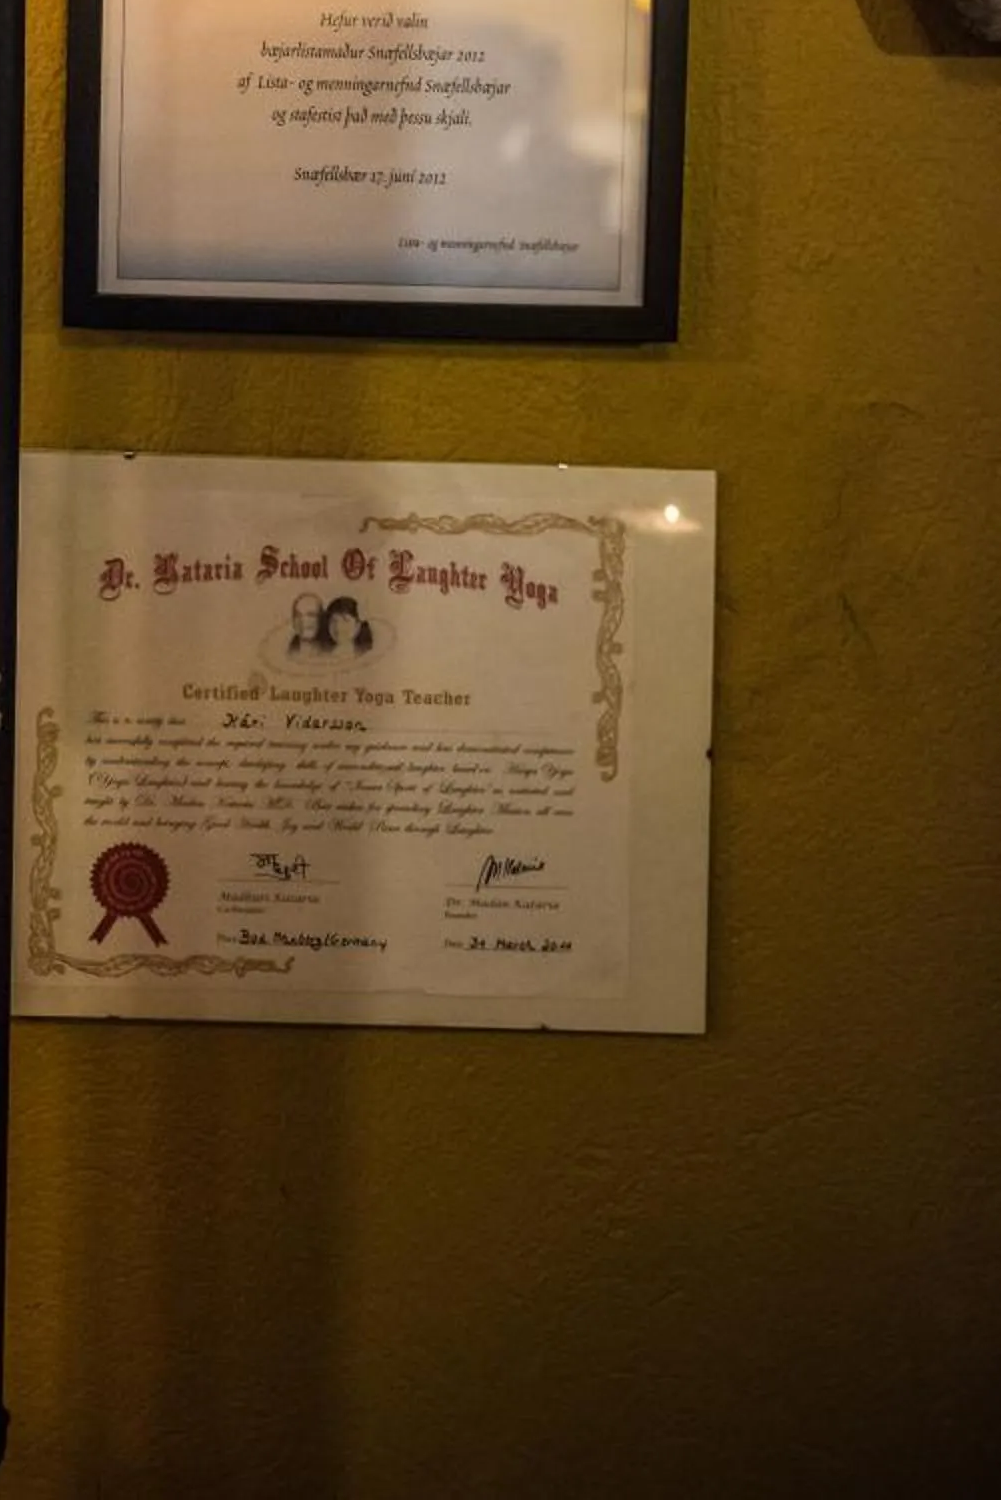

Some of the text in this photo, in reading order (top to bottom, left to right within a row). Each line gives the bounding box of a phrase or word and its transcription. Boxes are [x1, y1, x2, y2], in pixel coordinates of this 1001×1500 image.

[319, 11, 359, 33] Hefur
[260, 41, 486, 66] bæjarlistamaður Snæfellsbæjar 2012
[298, 78, 313, 96] og
[270, 109, 287, 127] og
[294, 166, 368, 188] Snæfellsbær
[418, 172, 447, 185] 2012
[99, 557, 141, 601] Dr.
[255, 545, 328, 585] School
[341, 547, 377, 582] Of
[182, 683, 472, 707] Certified Laughter Yoga Teacher
